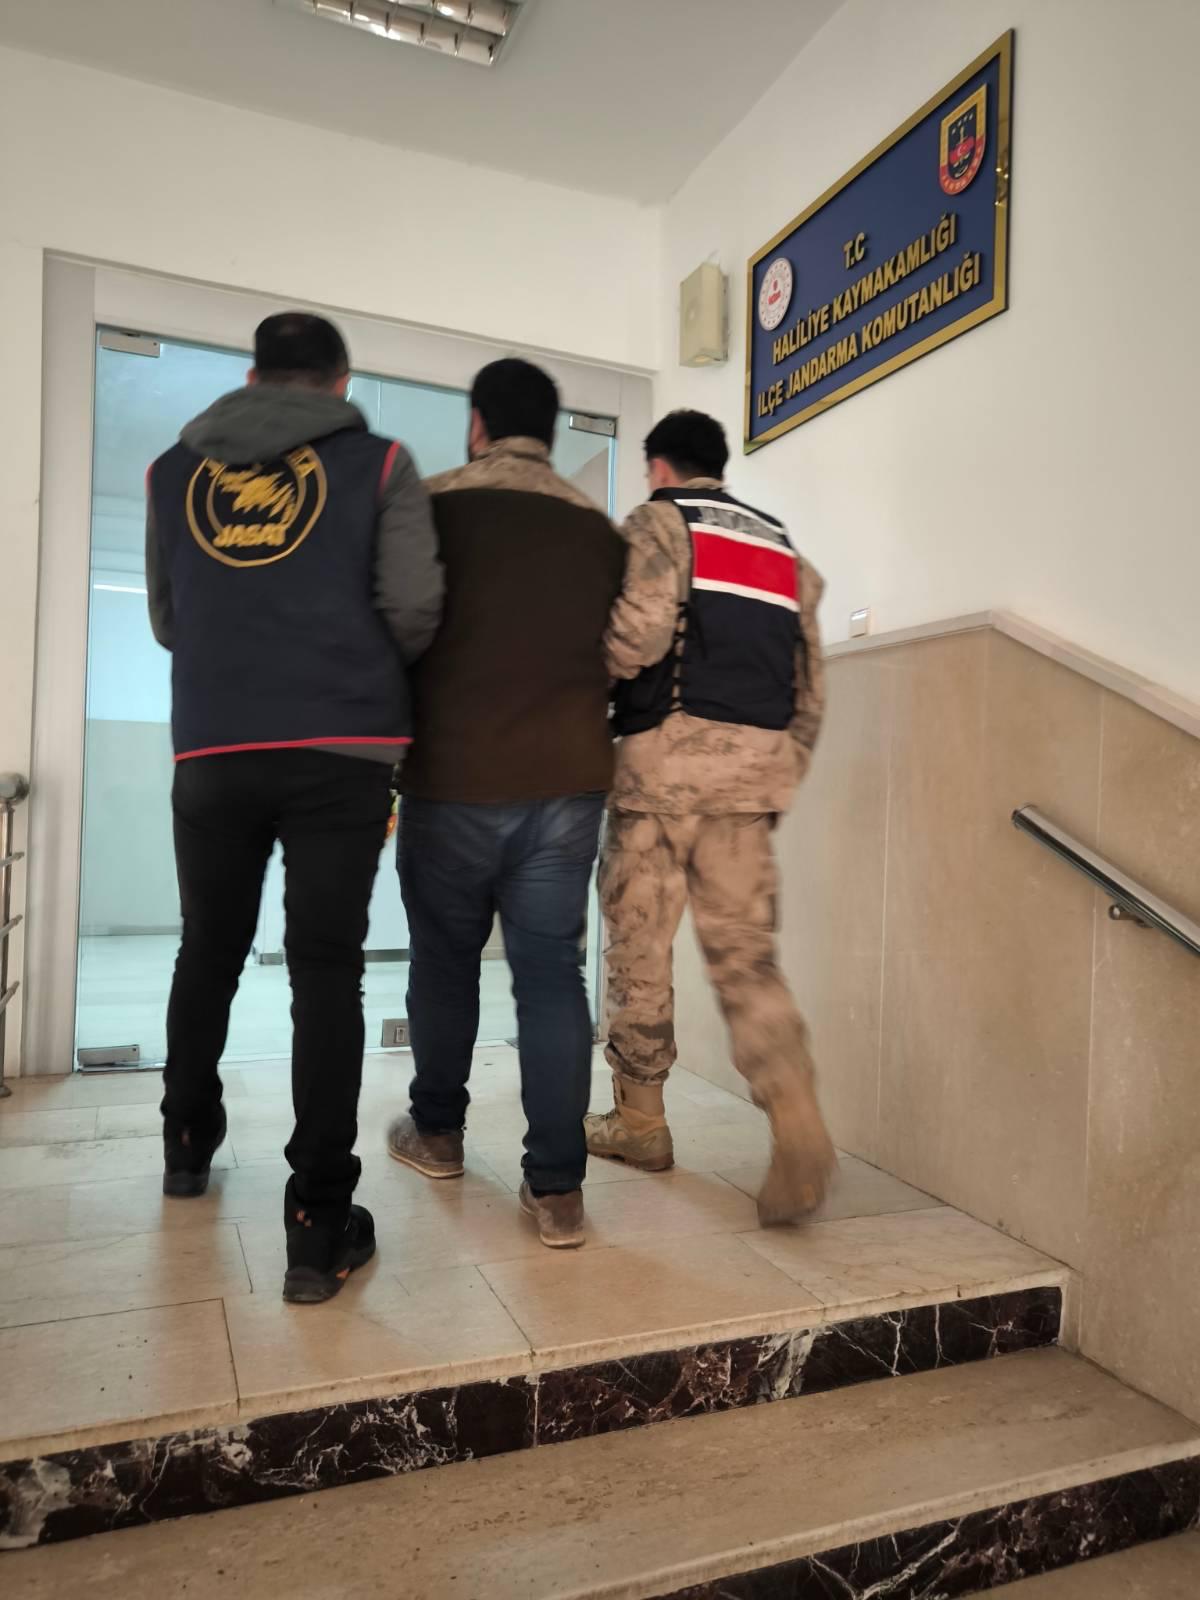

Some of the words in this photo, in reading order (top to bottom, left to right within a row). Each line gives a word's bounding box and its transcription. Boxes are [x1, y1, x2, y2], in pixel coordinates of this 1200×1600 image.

[772, 303, 830, 365] HALİLİYE
[832, 213, 957, 324] KAYMAKAMLIĞI
[786, 332, 858, 399] JANDARMA
[861, 251, 981, 353] KOMUTANLIĞI
